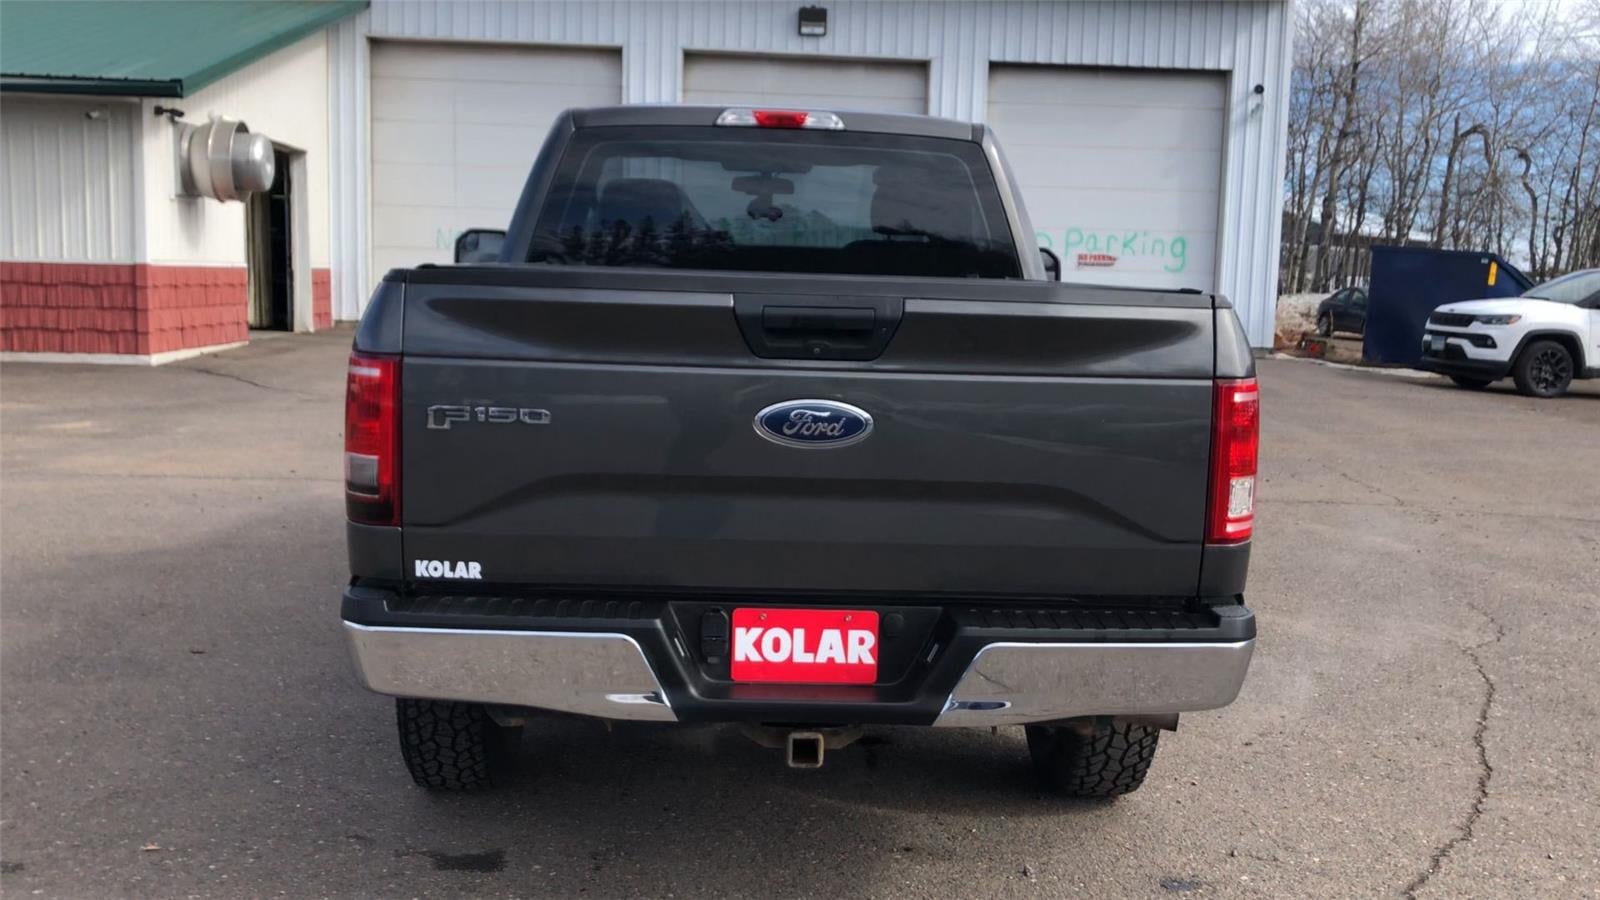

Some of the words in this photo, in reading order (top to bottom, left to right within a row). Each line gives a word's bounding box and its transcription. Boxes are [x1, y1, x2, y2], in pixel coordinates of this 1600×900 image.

[782, 409, 846, 436] Ford
[415, 559, 482, 579] KOLAR
[734, 627, 876, 664] KOLAR
